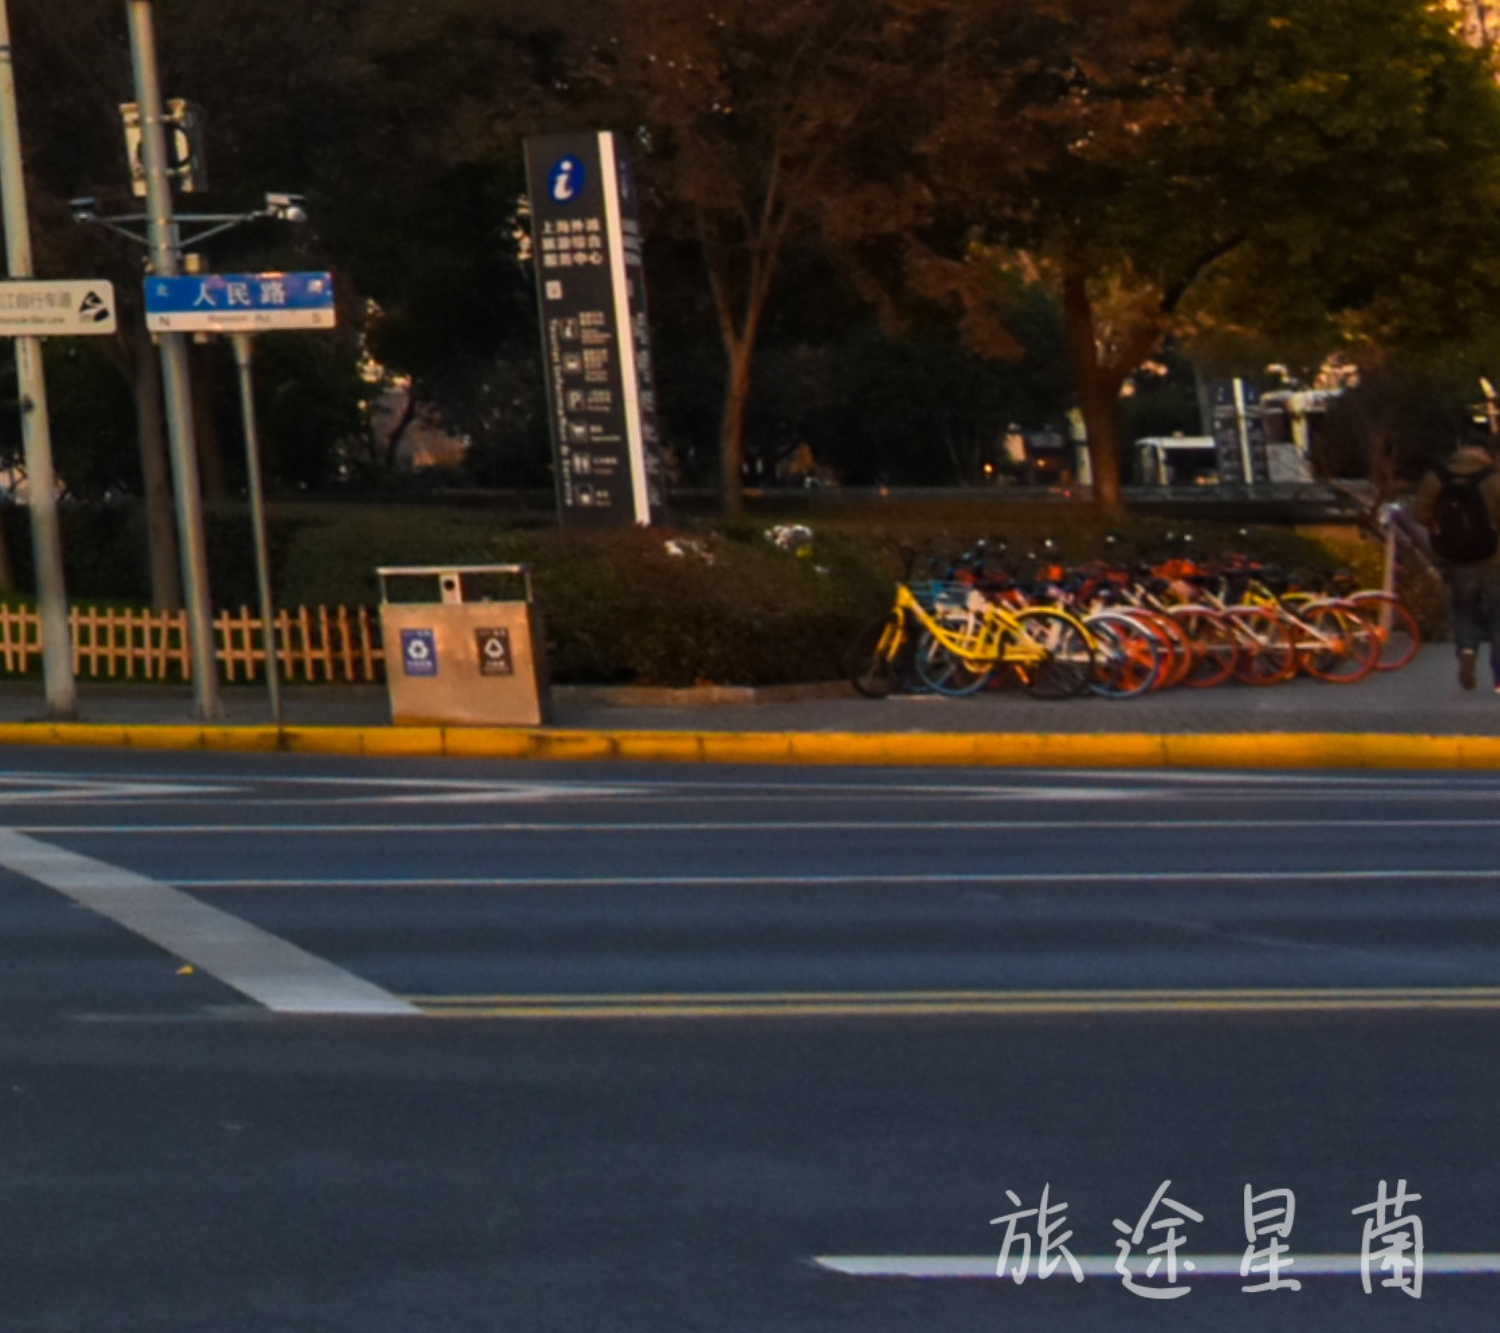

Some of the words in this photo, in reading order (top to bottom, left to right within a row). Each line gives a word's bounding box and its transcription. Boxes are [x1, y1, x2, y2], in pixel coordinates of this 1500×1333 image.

[193, 281, 286, 306] 人民路
[159, 315, 170, 326] N
[312, 313, 321, 324] S
